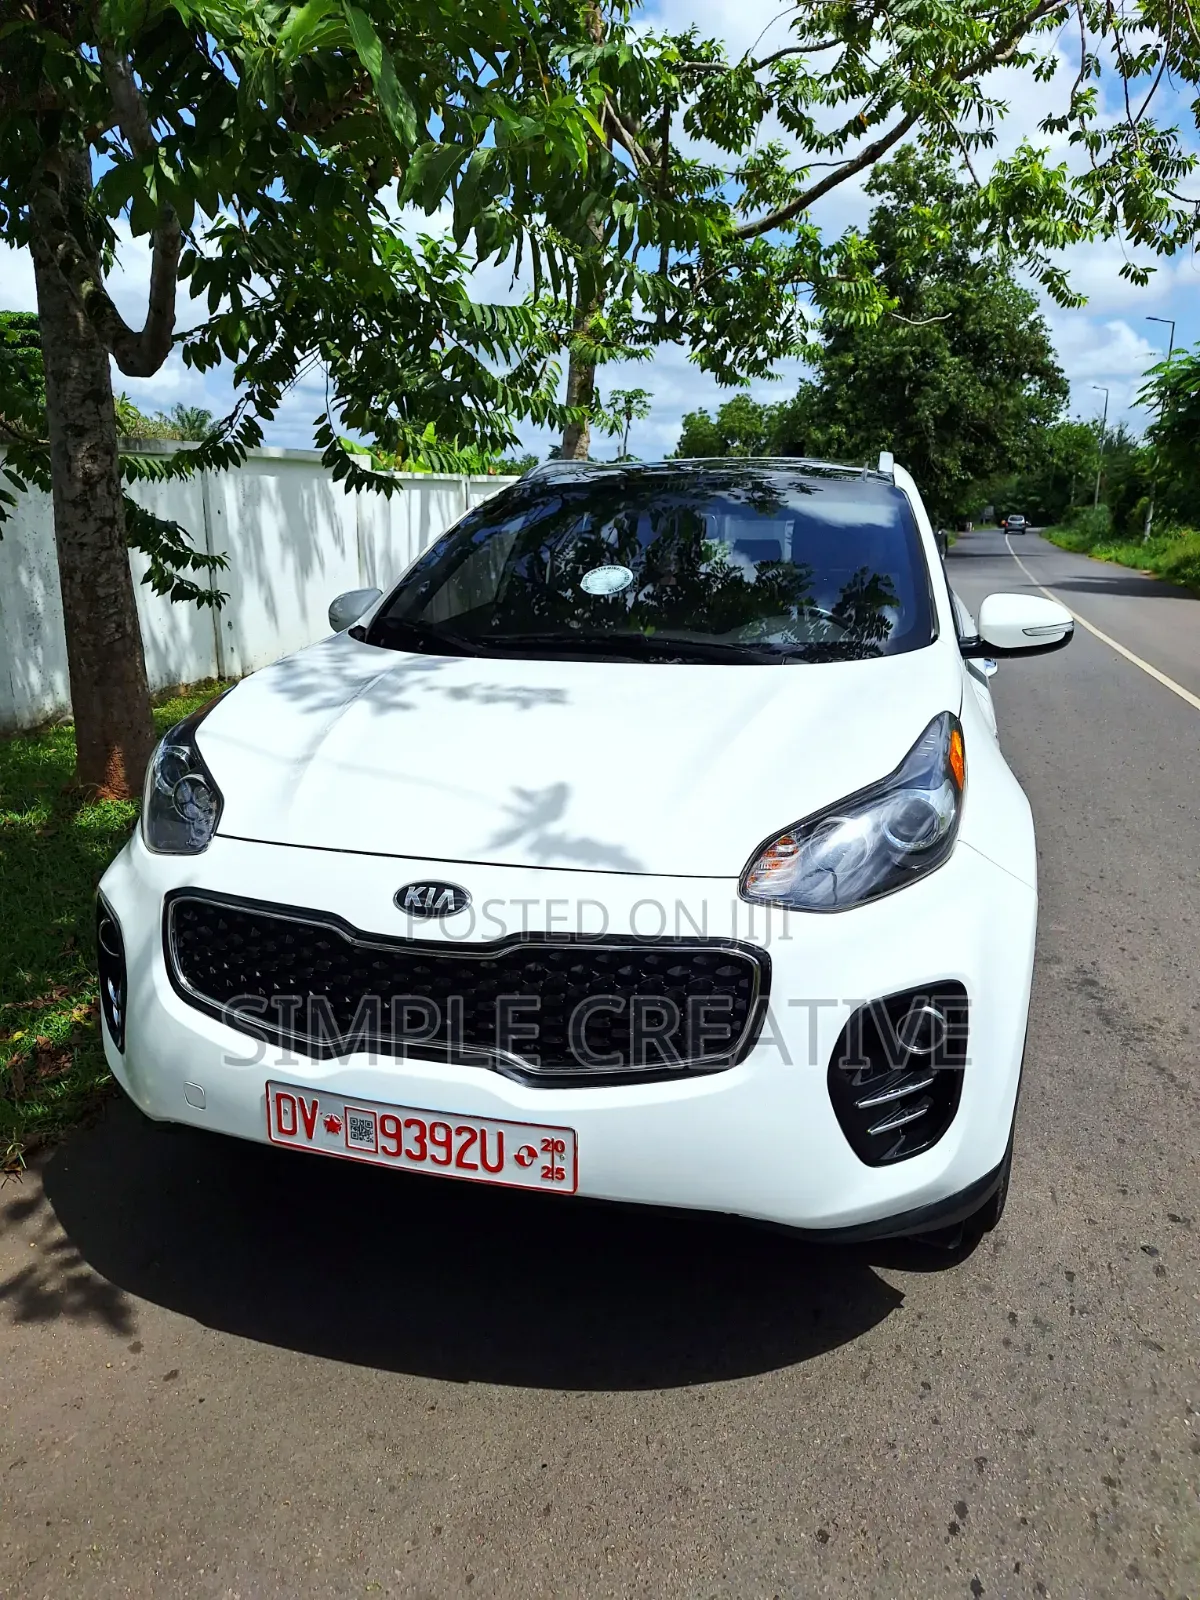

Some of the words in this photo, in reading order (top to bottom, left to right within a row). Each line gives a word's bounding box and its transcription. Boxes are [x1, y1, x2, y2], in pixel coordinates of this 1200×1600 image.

[404, 886, 457, 912] KIA
[275, 1092, 319, 1140] DV
[379, 1114, 505, 1173] 9392U
[540, 1138, 566, 1154] 20
[540, 1165, 566, 1181] 25
